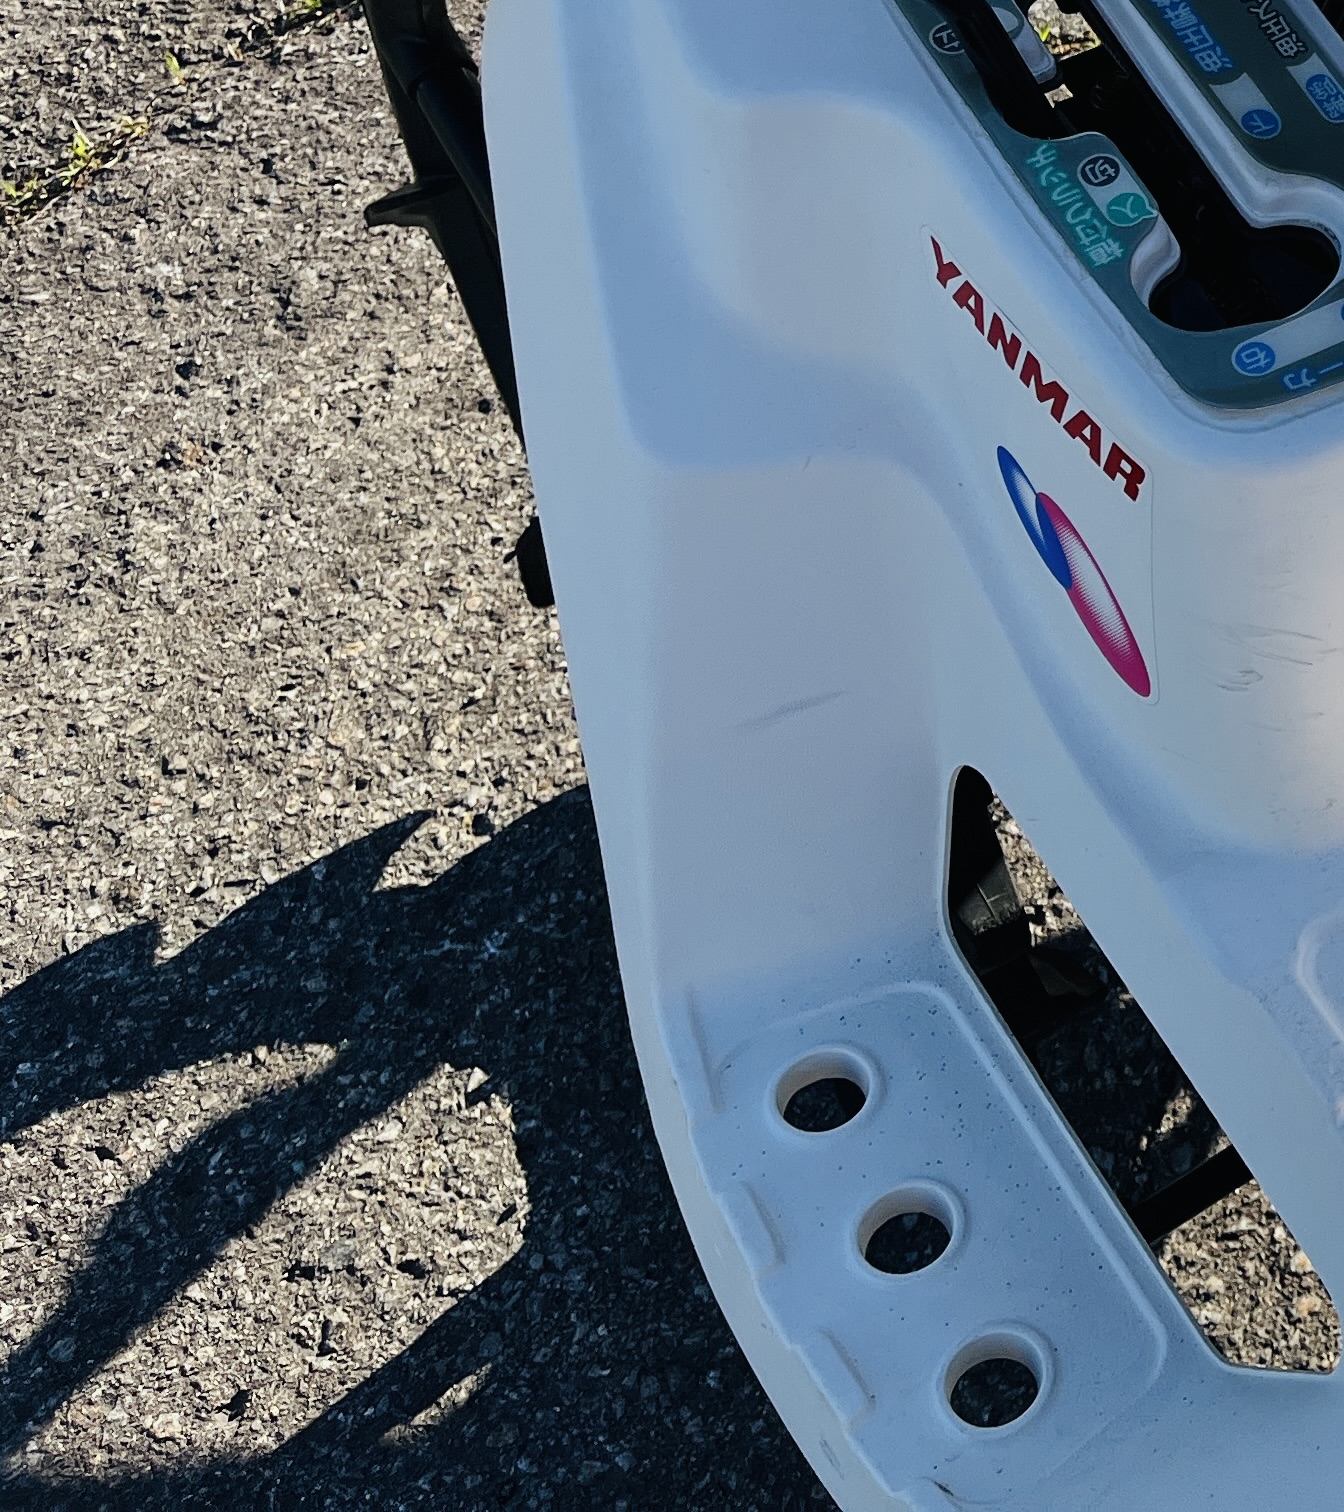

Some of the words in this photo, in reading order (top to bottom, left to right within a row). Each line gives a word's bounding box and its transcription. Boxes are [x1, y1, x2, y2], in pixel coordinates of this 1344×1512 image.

[1244, 112, 1274, 133] 下
[1086, 160, 1115, 182] 切
[1026, 143, 1123, 266] 植付クラッチ
[1109, 195, 1138, 217] 入
[931, 235, 1147, 502] YANMAR
[1240, 347, 1271, 370] 右
